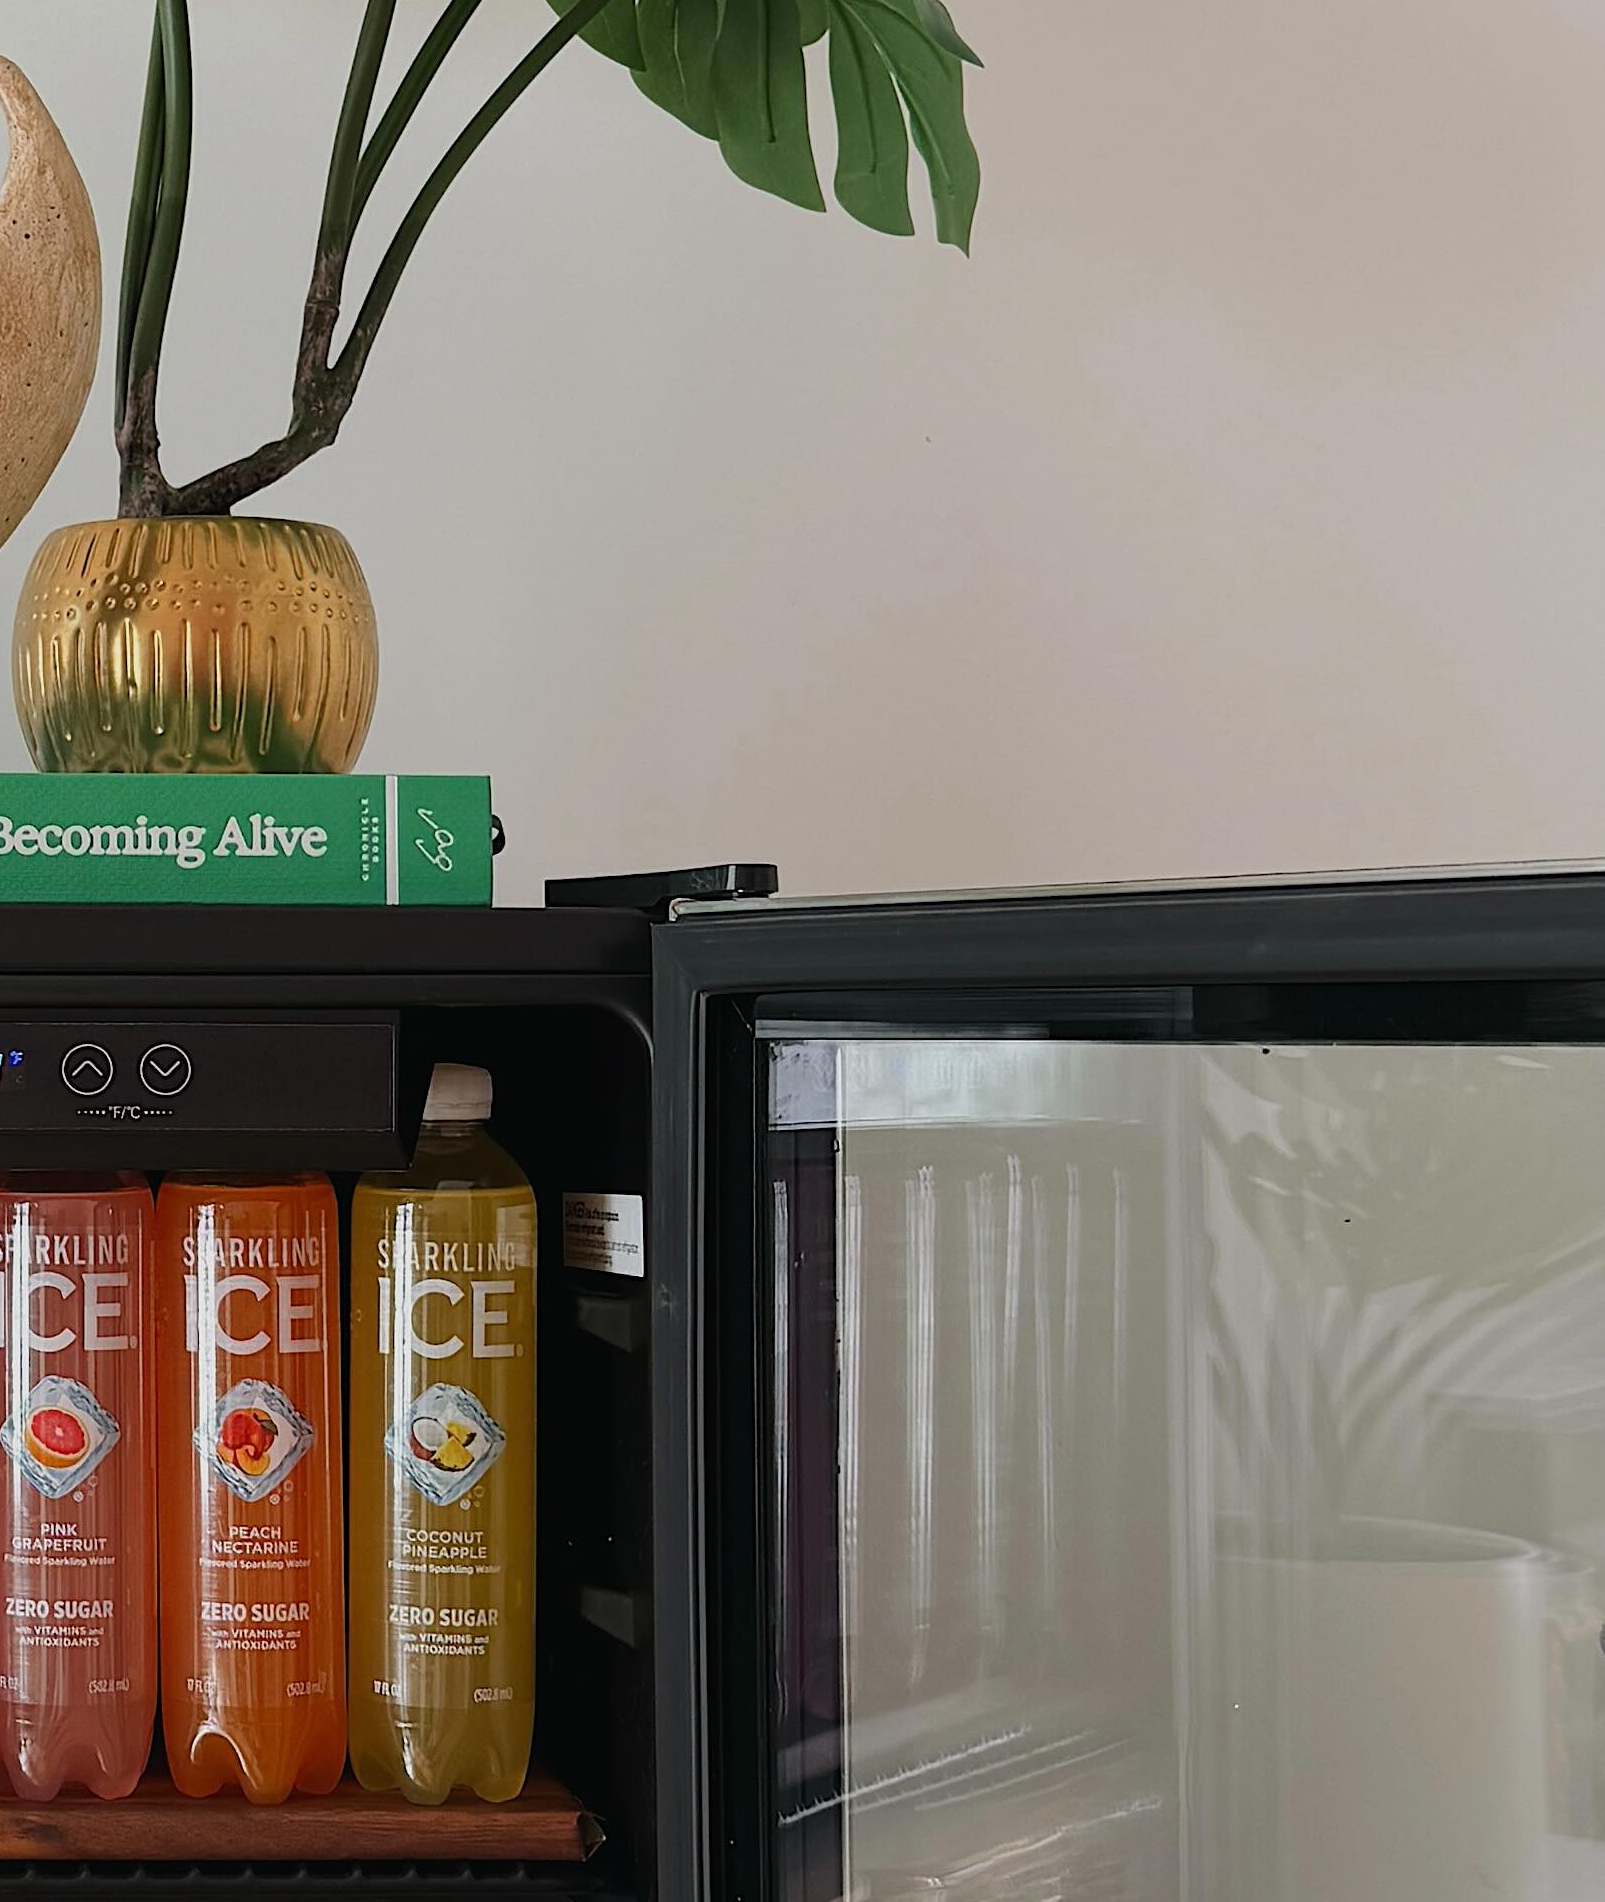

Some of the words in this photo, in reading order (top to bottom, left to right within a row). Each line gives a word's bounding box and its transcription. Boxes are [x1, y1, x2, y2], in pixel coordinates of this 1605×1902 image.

[213, 813, 328, 857] Alive
[361, 798, 369, 881] CHRONICLE
[183, 1236, 319, 1268] SARKLING
[378, 1239, 515, 1272] SARKLING
[184, 1275, 320, 1355] ICE
[378, 1277, 515, 1359] ICE
[41, 1523, 77, 1536] PINK
[229, 1526, 281, 1539] PEACH
[407, 1530, 483, 1543] COCONUT
[12, 1537, 107, 1551] GRAPEFRUIT
[212, 1540, 299, 1555] NECTARINE
[403, 1545, 487, 1559] PINEAPPLE
[43, 1556, 87, 1566] Sparkling
[6, 1598, 49, 1618] ZERO
[54, 1600, 113, 1618] SUGAR
[202, 1602, 246, 1621] ZERO
[252, 1603, 310, 1622] SUGAR
[389, 1605, 434, 1626] ZERO
[439, 1609, 498, 1626] SUGAR
[34, 1626, 86, 1635] VITAMINS
[232, 1629, 283, 1638] VITAMINS
[19, 1637, 99, 1647] ANTIOXIDANTS
[215, 1640, 297, 1650] ANTIOXIDANTS
[420, 1633, 472, 1644] VITAMINS
[403, 1644, 485, 1655] ANTIOXIDANTS
